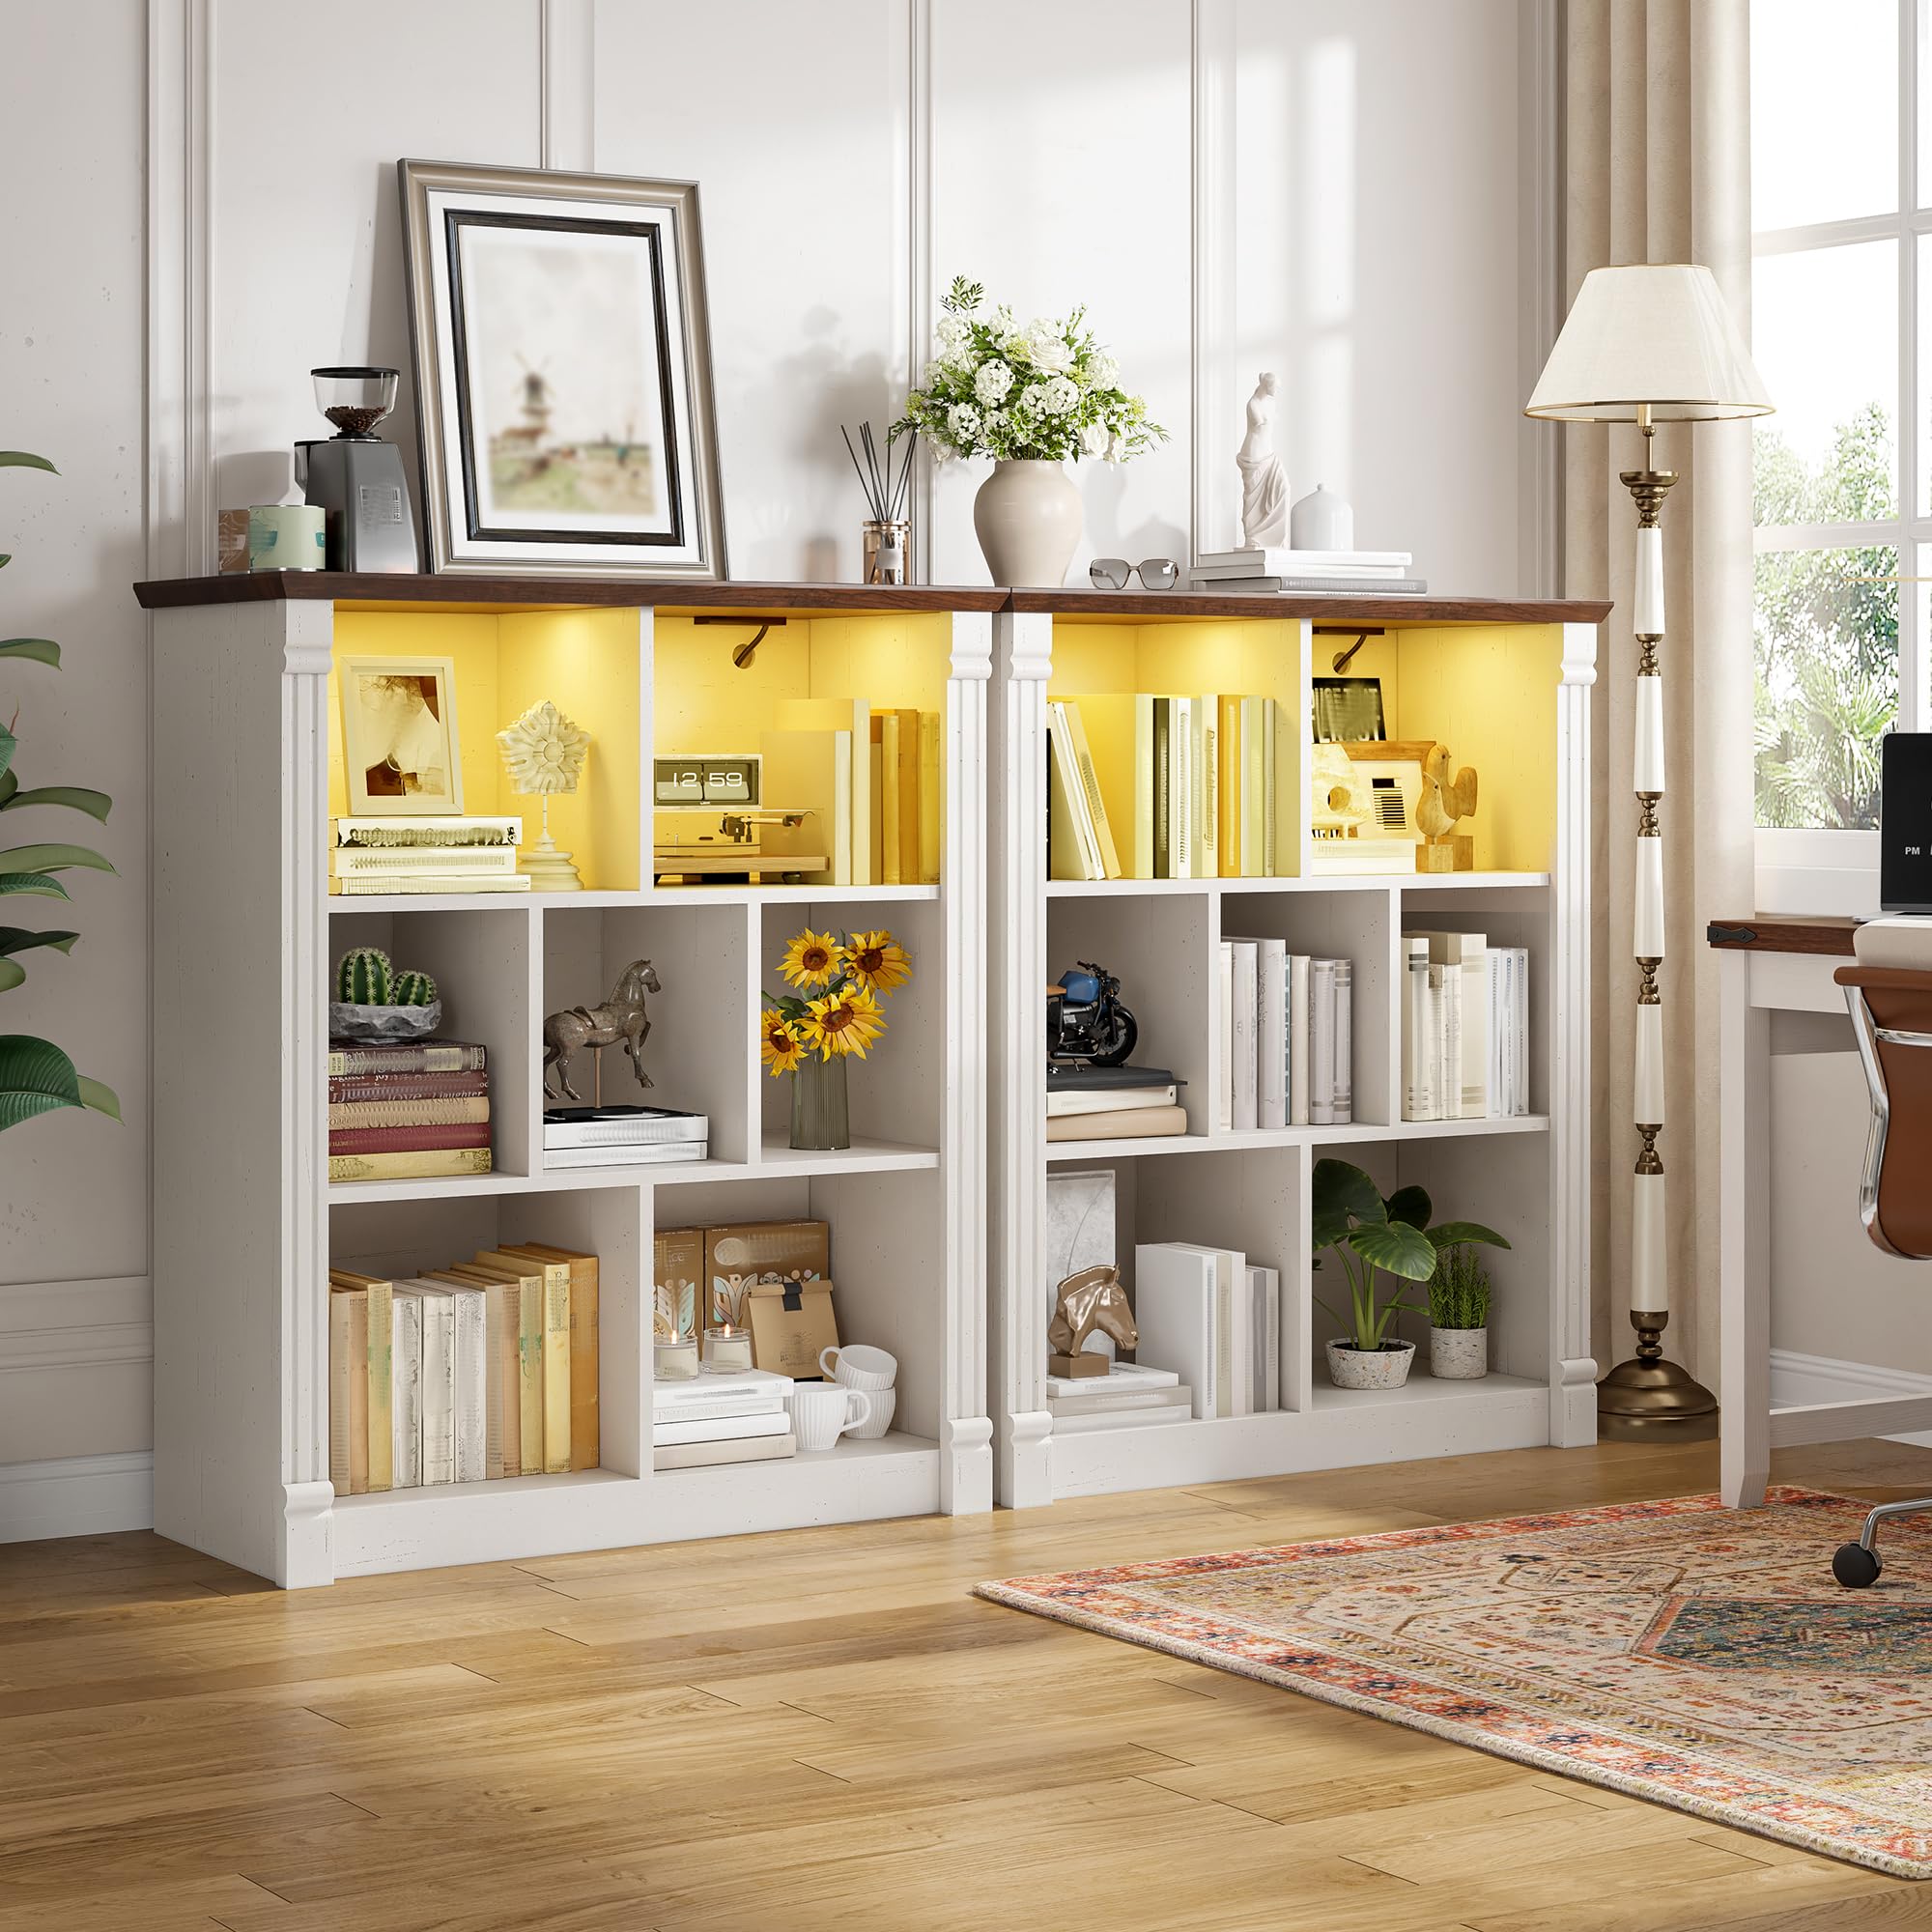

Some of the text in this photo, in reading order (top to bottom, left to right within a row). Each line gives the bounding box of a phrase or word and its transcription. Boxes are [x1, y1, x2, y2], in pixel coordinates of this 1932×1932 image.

[673, 772, 743, 787] 12 59
[1905, 846, 1920, 855] PM
